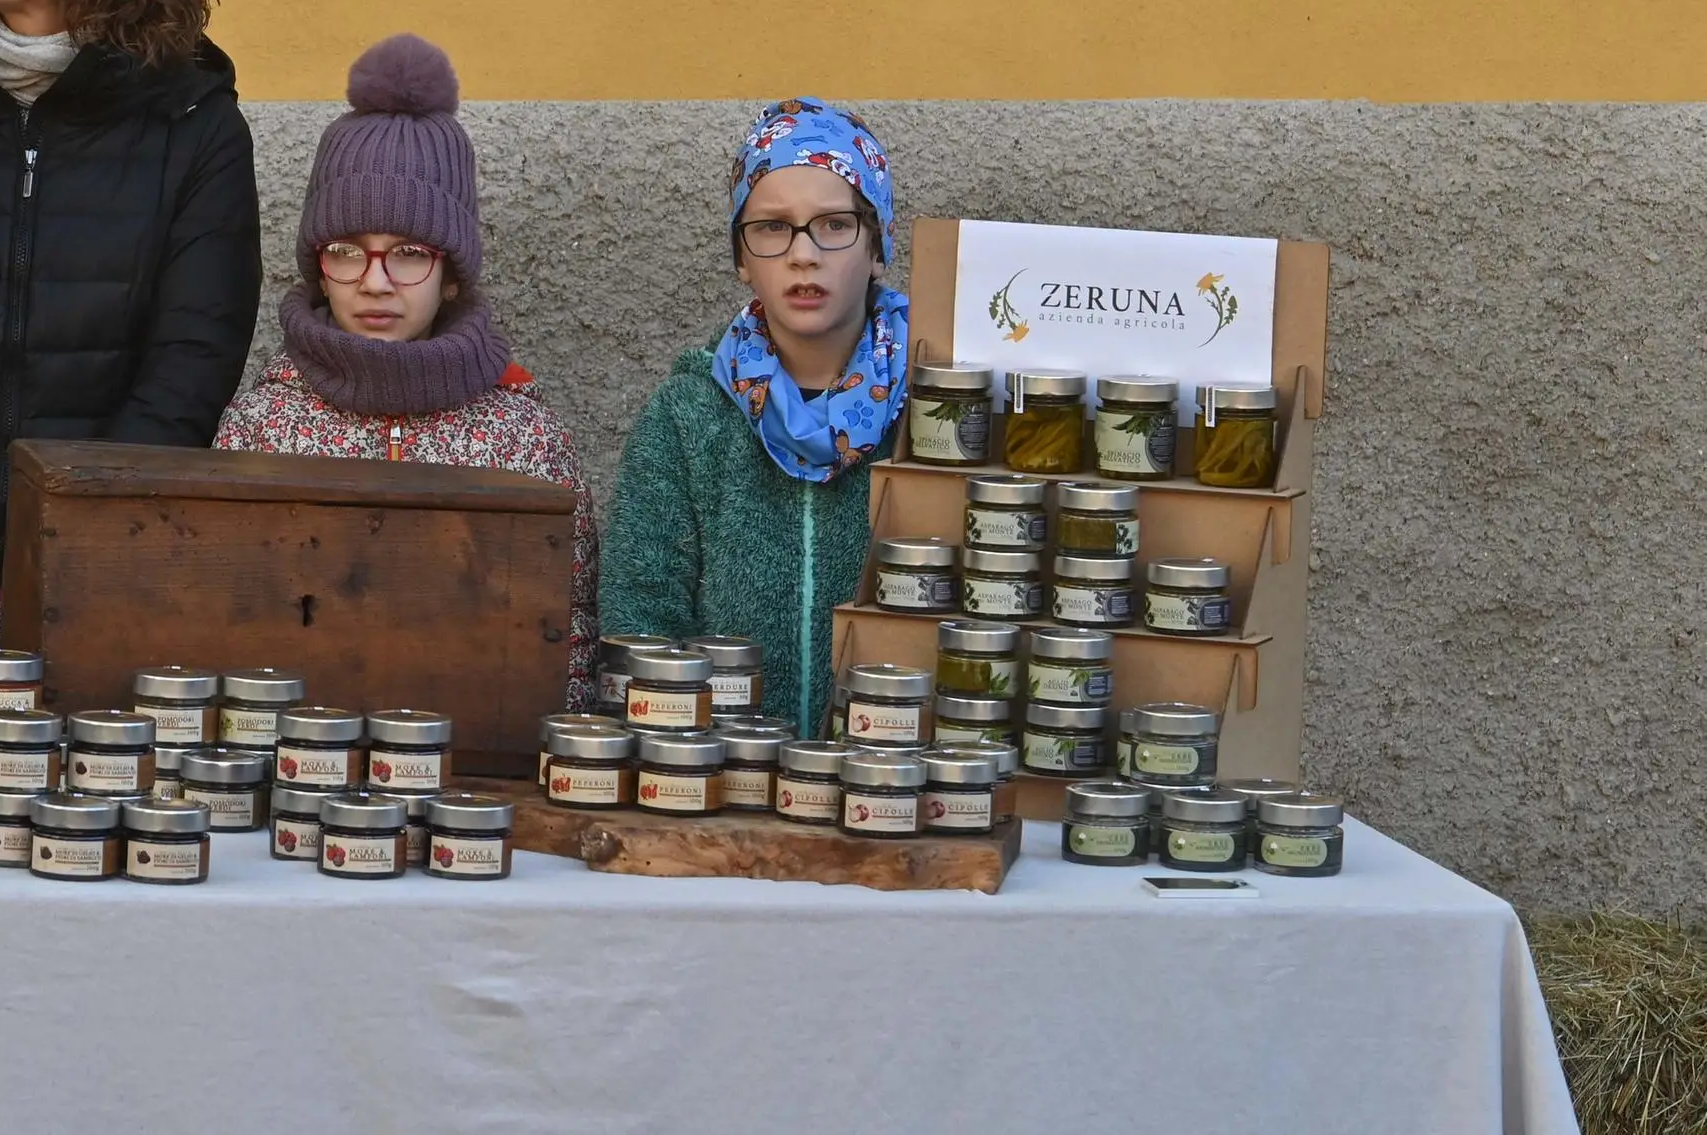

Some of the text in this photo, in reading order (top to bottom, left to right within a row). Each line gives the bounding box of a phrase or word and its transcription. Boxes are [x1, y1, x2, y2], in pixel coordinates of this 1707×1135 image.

[1040, 282, 1186, 316] ZERUNA
[1039, 312, 1185, 331] azienda agricola
[873, 718, 915, 726] CIPOLLE
